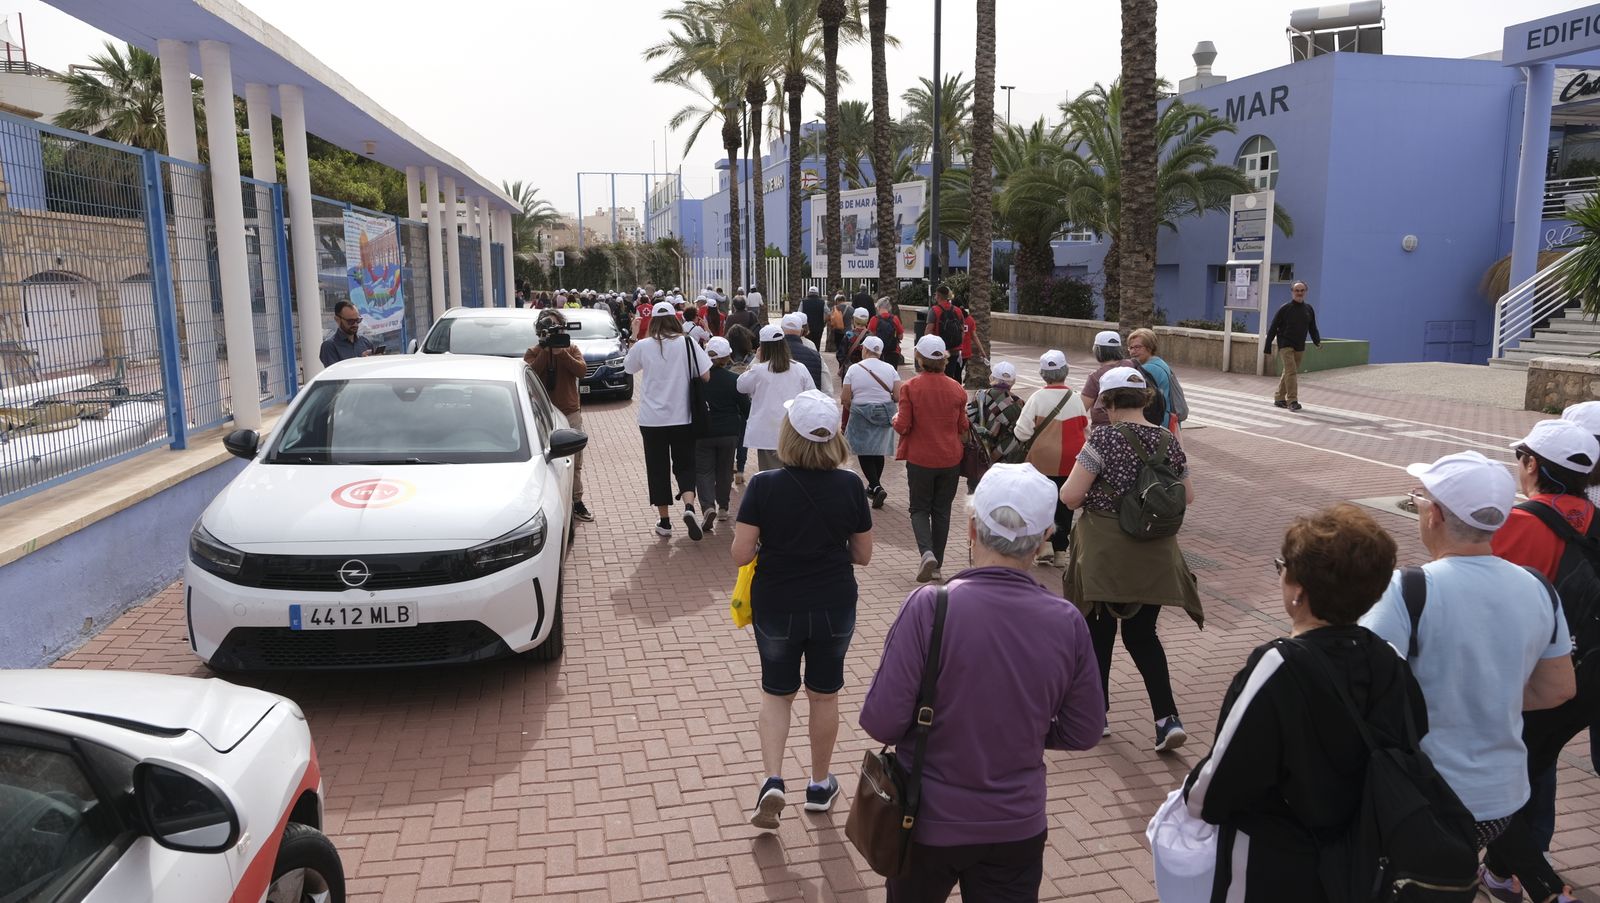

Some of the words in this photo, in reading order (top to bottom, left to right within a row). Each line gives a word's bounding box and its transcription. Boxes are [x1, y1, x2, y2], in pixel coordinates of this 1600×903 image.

[1226, 85, 1289, 123] MAR
[845, 200, 853, 209] DE
[855, 198, 870, 208] MAR
[848, 260, 856, 268] TU
[857, 259, 874, 269] CLUB
[310, 607, 362, 625] 4412
[370, 606, 410, 624] MLB
